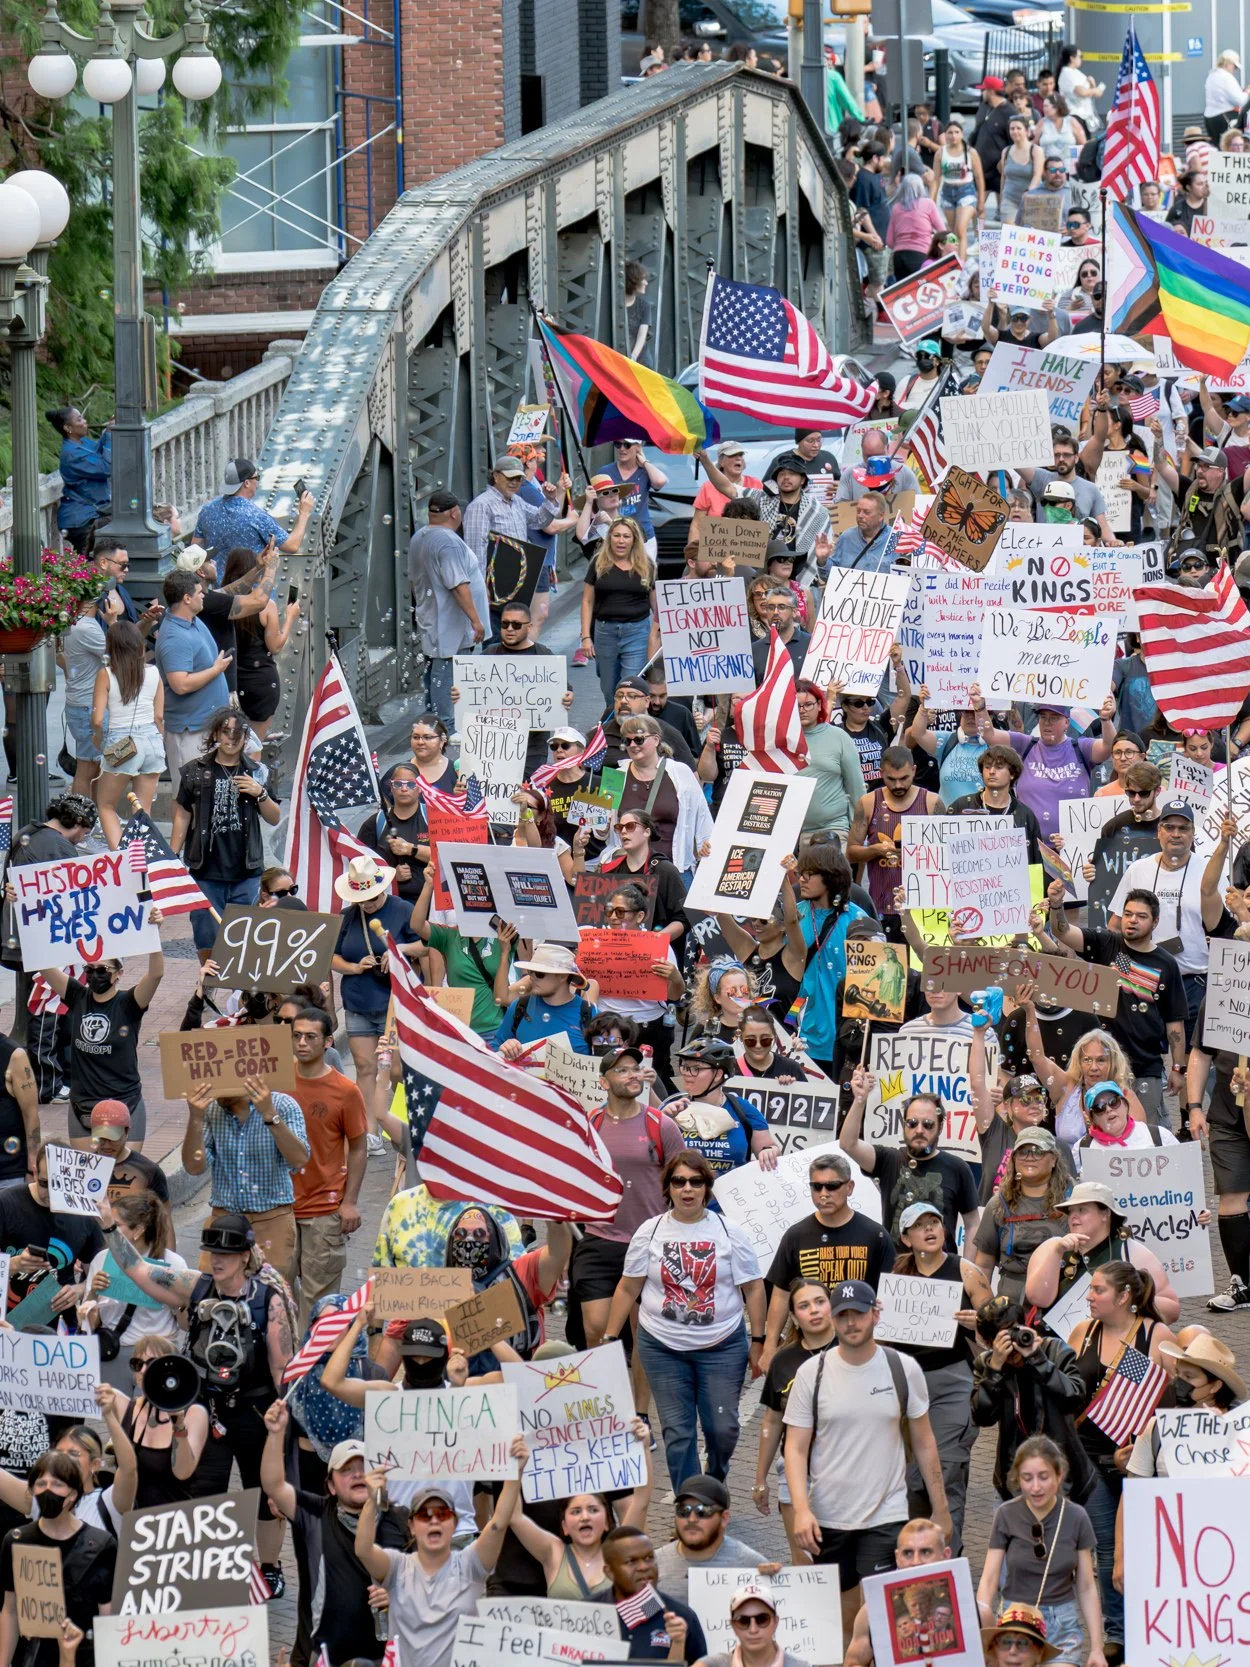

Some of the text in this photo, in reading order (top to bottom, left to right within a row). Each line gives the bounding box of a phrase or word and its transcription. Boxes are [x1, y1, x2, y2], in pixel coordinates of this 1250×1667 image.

[1223, 155, 1250, 170] THIS
[1211, 171, 1232, 184] THE
[1009, 230, 1055, 248] HUMAN
[1005, 246, 1053, 263] RIGHTS
[1001, 259, 1052, 278] BELONG
[1041, 354, 1087, 378] HAVE
[1009, 368, 1076, 392] FRIENDS
[949, 467, 981, 493] FIGHT
[924, 527, 981, 571] DREAMERS
[661, 581, 730, 605] FIGHT
[1013, 579, 1090, 602] KINGS
[661, 605, 747, 634] IGNORANCE
[689, 630, 720, 649] NOT
[666, 655, 754, 685] IMMIGRANTS
[1019, 651, 1079, 665] means
[743, 821, 770, 830] DISTRESS
[731, 849, 743, 859] ICE
[19, 854, 123, 897] HISTORY
[719, 881, 752, 892] GESTAPO
[722, 870, 756, 883] AMERICAN
[954, 876, 1004, 897] RESISTANCE
[21, 887, 100, 925] HAS ITS
[993, 907, 1027, 925] DUTY!
[50, 906, 142, 943] EYES ON
[224, 917, 326, 975] 99%
[931, 955, 1099, 995] SHAME ON YOU
[181, 1038, 270, 1062] RED RED
[189, 1058, 279, 1079] HAT COAT
[820, 1260, 844, 1281] SPEAK
[33, 1340, 87, 1369] DAD
[375, 1392, 495, 1435] CHINGA
[521, 1394, 614, 1431] NO KINGS
[430, 1431, 457, 1448] TU
[536, 1419, 625, 1449] SINCE 1776
[1155, 1493, 1234, 1587] NO
[119, 1586, 181, 1616] AND
